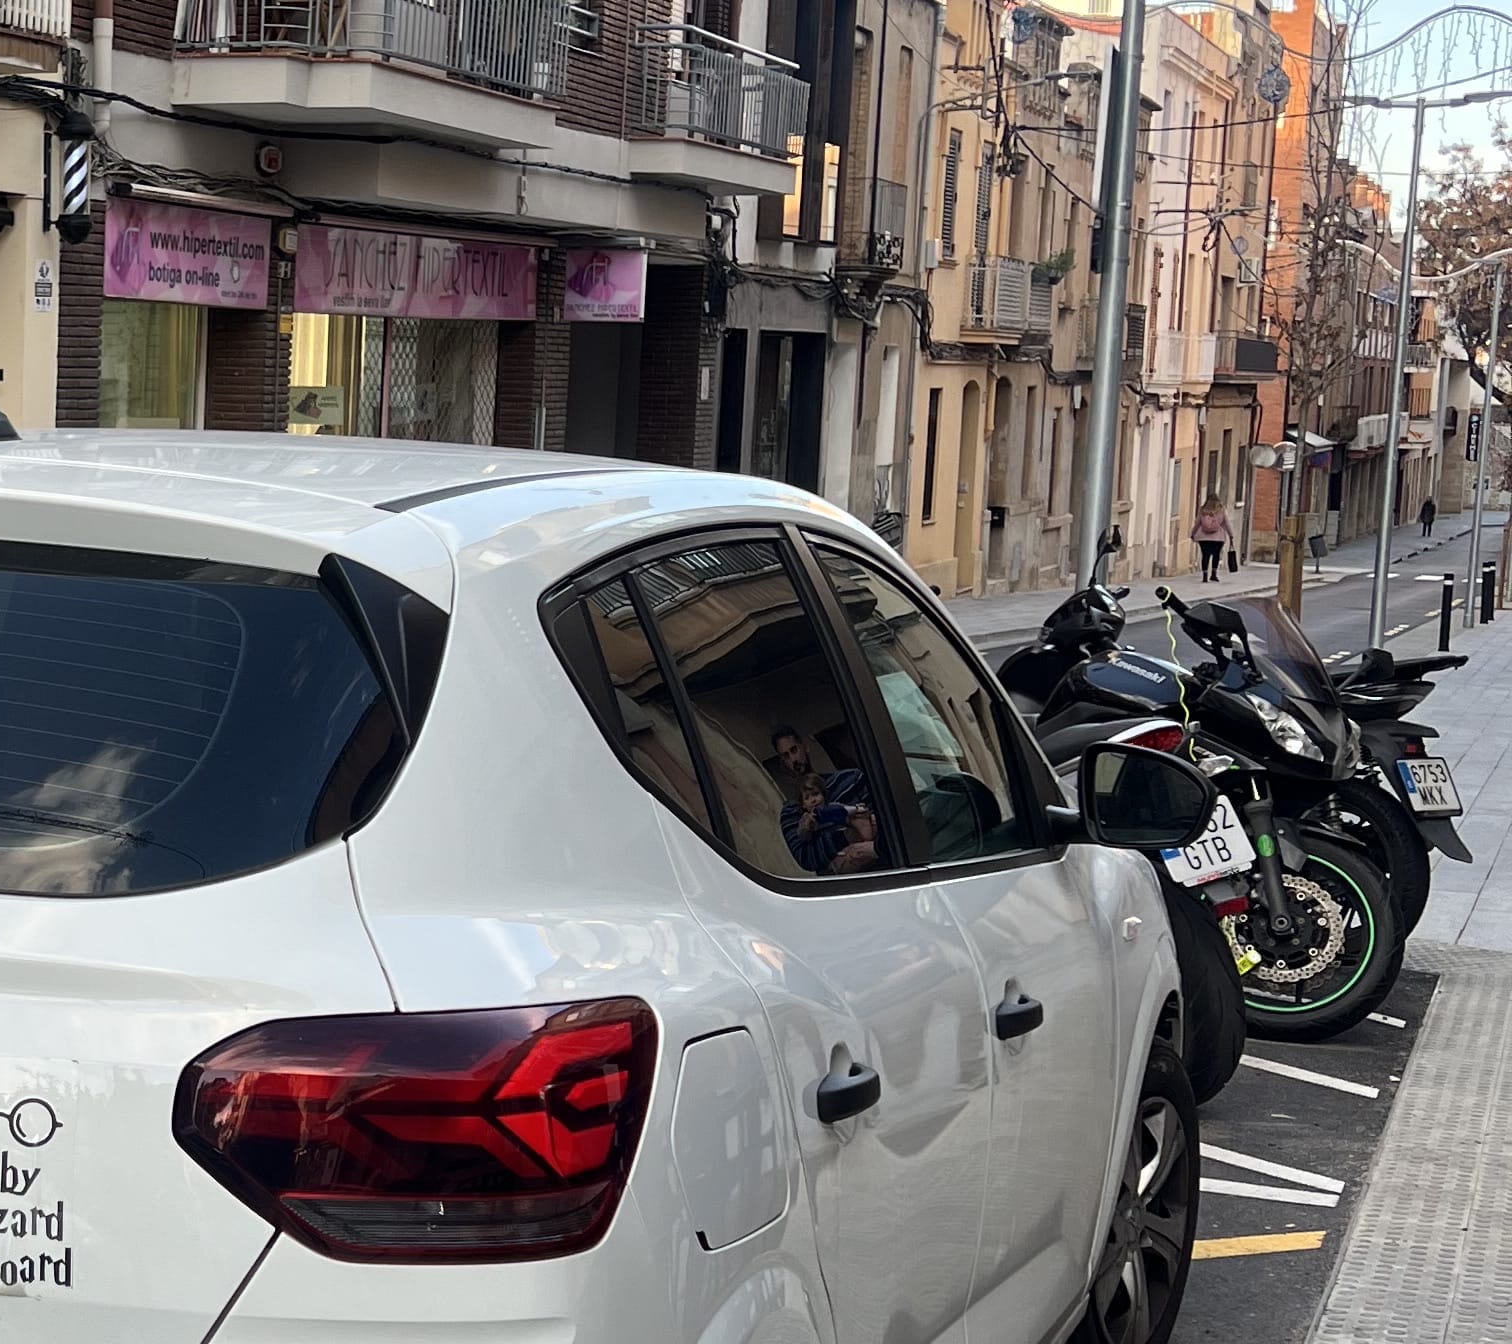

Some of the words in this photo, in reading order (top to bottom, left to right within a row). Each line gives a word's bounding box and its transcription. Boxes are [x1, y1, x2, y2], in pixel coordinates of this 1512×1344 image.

[150, 230, 265, 261] www.hipertextil.com
[148, 261, 182, 288] botiga
[185, 266, 221, 287] on-line
[325, 235, 407, 292] SANCHEZ
[414, 242, 508, 298] HIPERTEXTIL
[1109, 656, 1167, 684] Kawasaki
[1410, 764, 1447, 783] 6753
[1417, 785, 1448, 805] MKX
[1184, 836, 1231, 870] GTB
